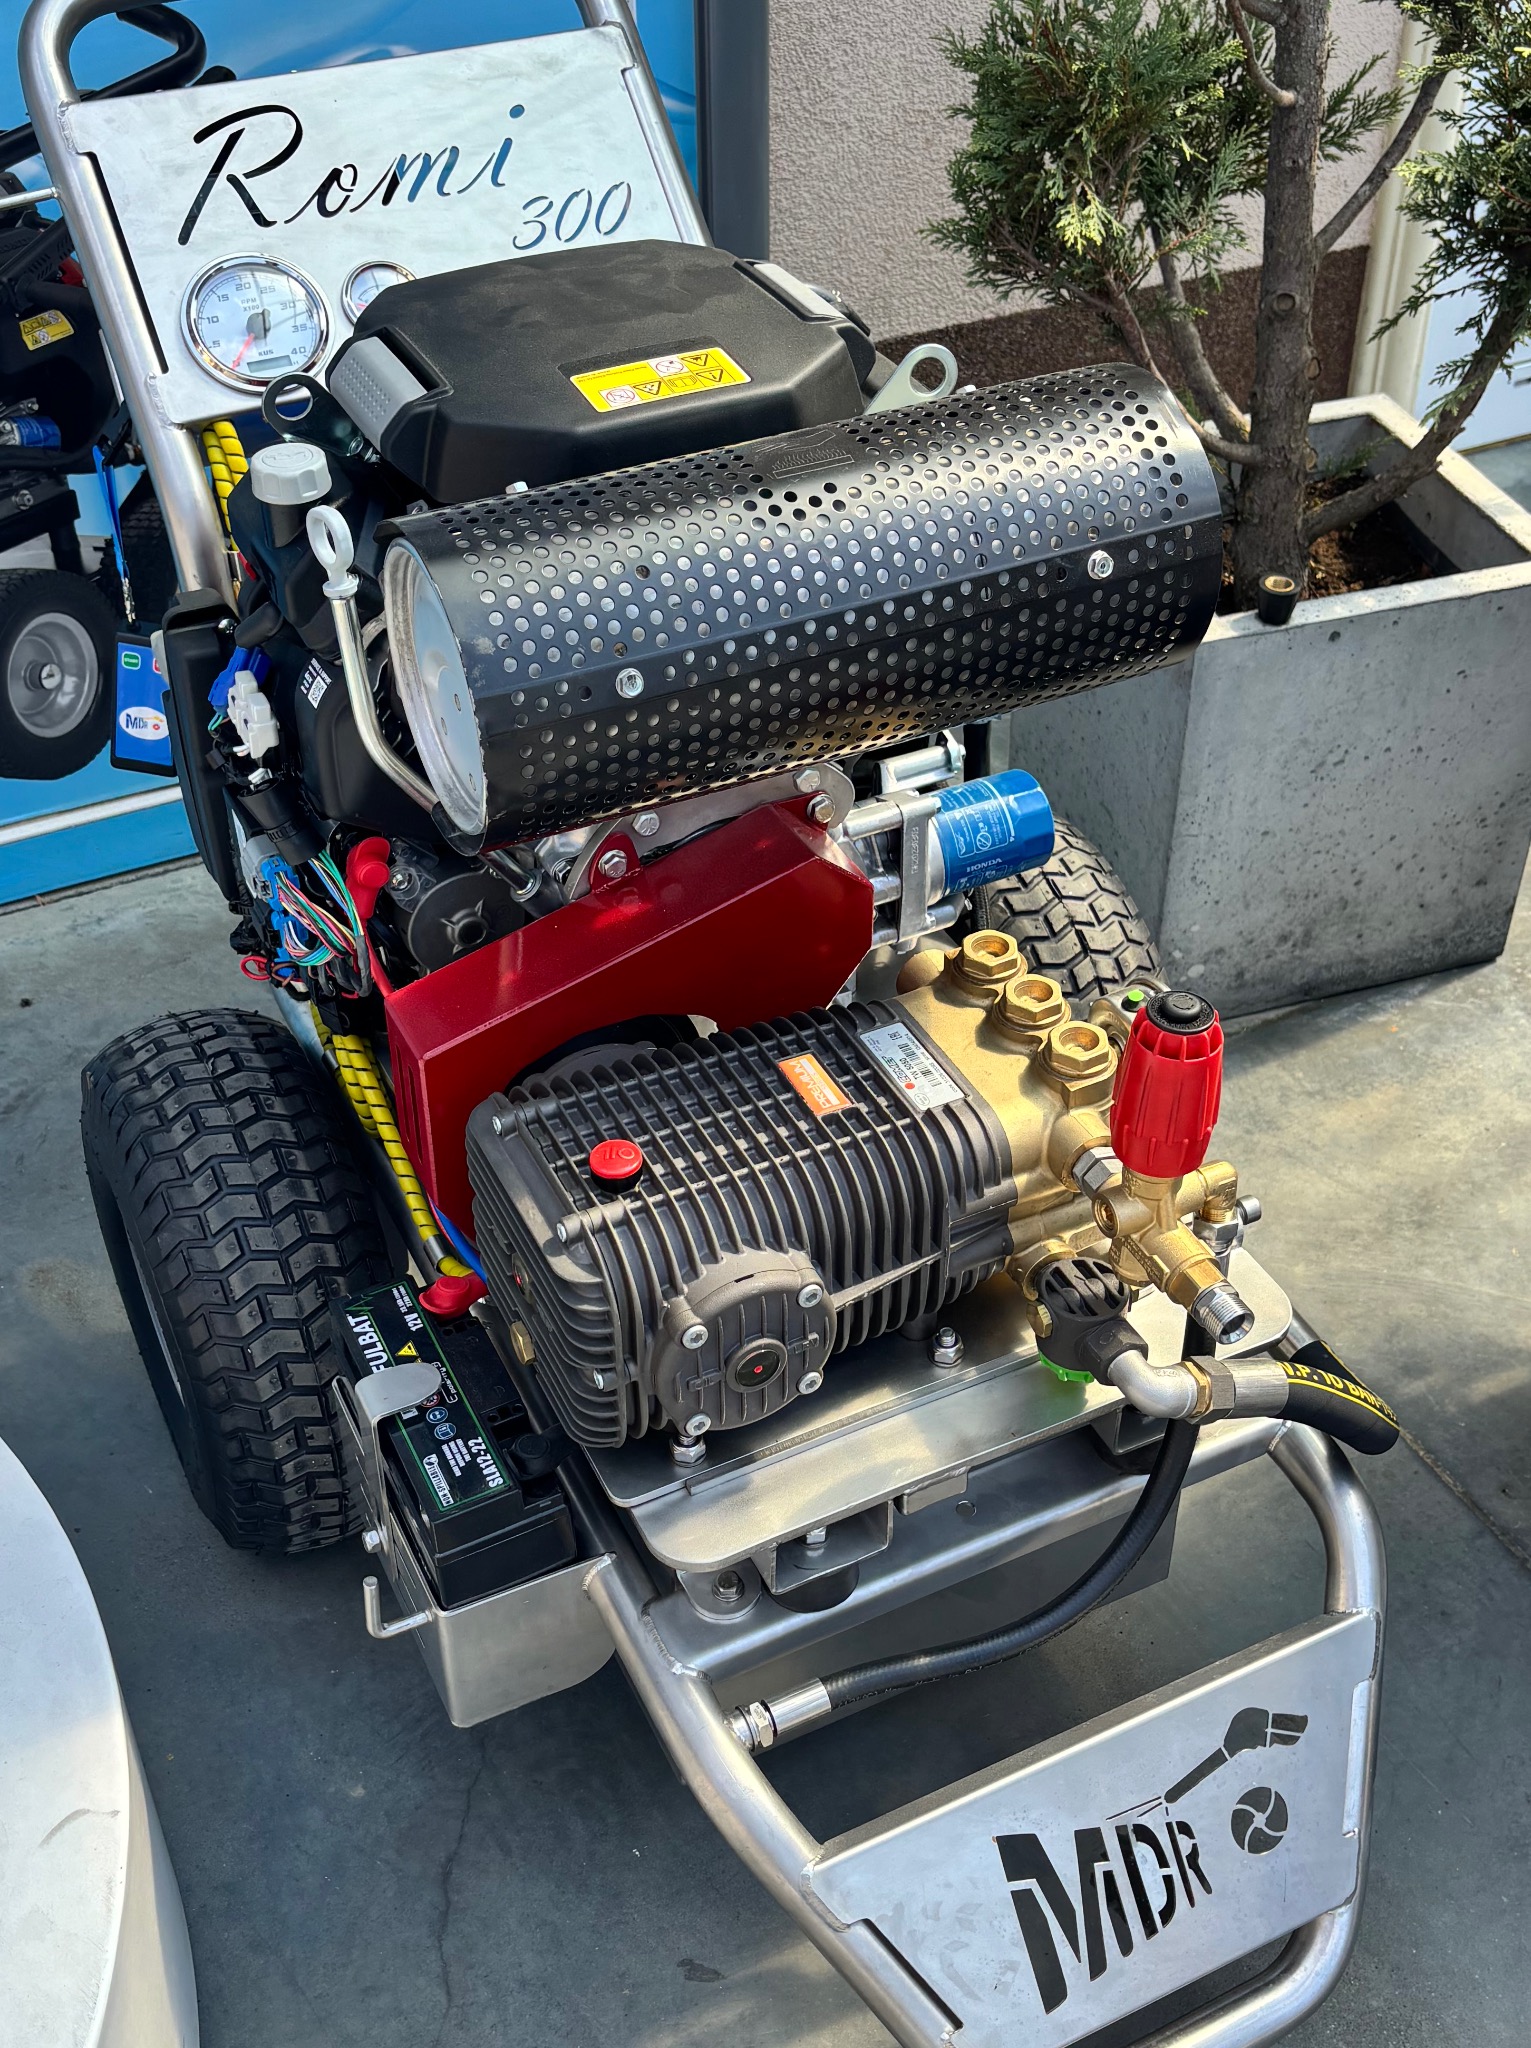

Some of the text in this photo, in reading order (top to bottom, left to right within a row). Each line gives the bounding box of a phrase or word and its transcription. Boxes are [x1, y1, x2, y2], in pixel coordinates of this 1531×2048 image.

[178, 104, 525, 246] Romi
[513, 181, 632, 250] 300
[235, 282, 251, 291] 20
[260, 286, 276, 294] 25
[217, 294, 229, 302] 15
[280, 302, 297, 310] 30
[206, 316, 219, 324] 10
[292, 324, 308, 333] 35
[291, 346, 307, 355] 40
[966, 858, 1002, 872] HONDA
[789, 1061, 831, 1108] PREMIUM
[404, 1313, 424, 1331] 12V
[468, 1437, 504, 1487] SLA12-22
[997, 1820, 1212, 2014] MDR
